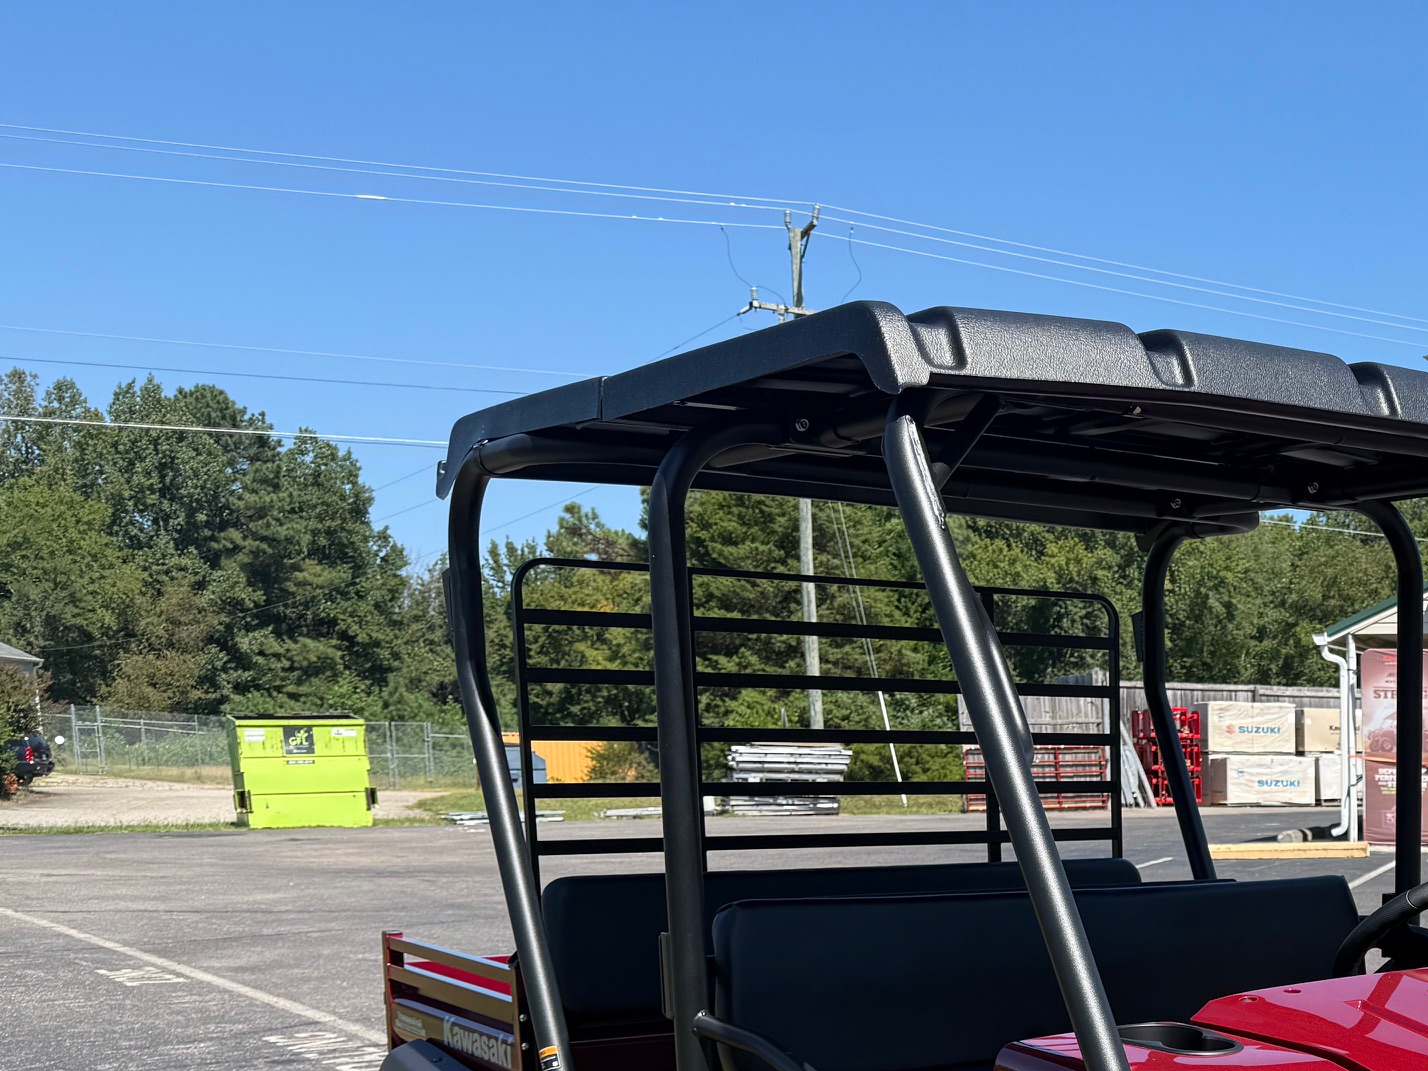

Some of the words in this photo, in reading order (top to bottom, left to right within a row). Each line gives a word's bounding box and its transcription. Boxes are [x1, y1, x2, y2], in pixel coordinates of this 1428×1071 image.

[1238, 725, 1281, 734] SUZUKI
[1257, 779, 1300, 788] SUZUKI
[442, 1014, 515, 1070] Kawasaki
